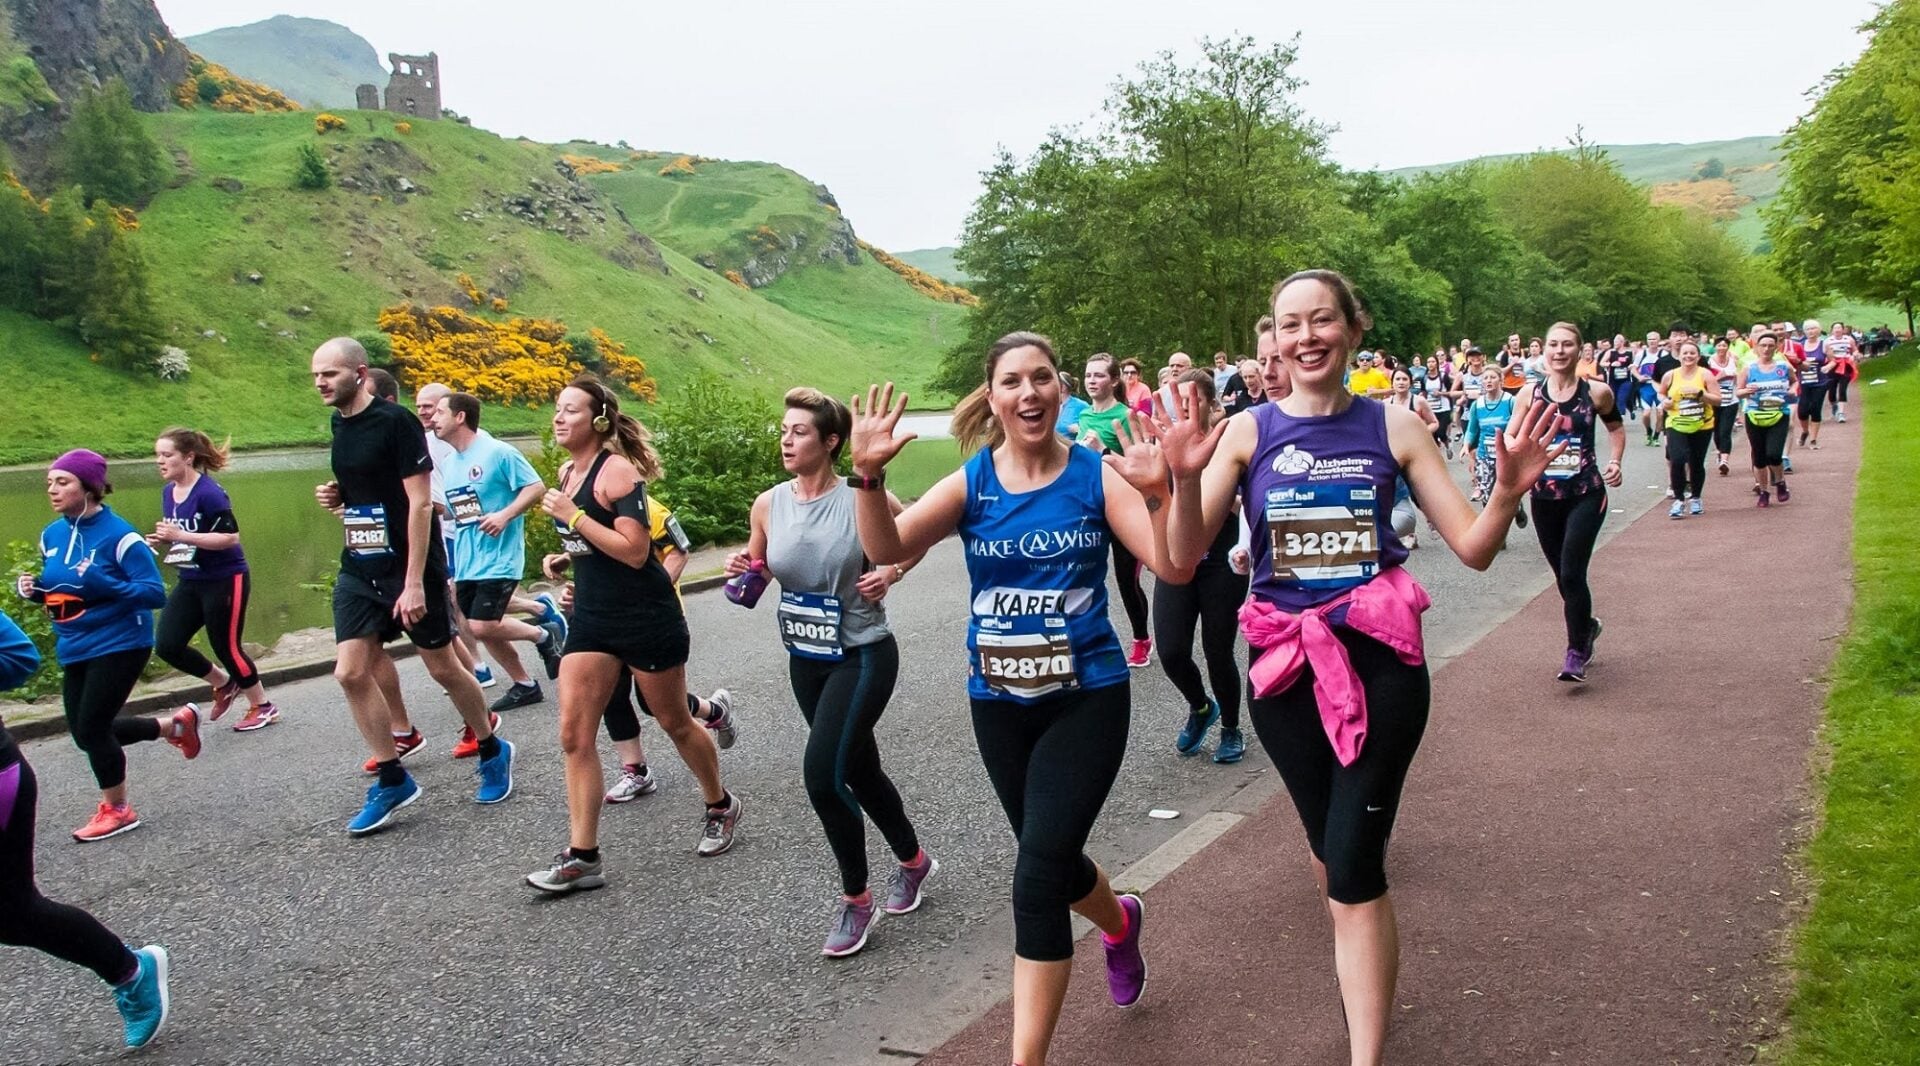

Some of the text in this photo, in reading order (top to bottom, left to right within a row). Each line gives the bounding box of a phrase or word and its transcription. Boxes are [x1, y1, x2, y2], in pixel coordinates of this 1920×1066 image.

[1314, 458, 1373, 469] Alzheimer
[1310, 466, 1363, 475] Scotland
[1296, 491, 1314, 501] half
[1354, 509, 1373, 517] 2016
[350, 529, 385, 545] 32187
[1285, 531, 1372, 557] 32871
[785, 620, 836, 641] 30012
[989, 654, 1071, 680] 32870
